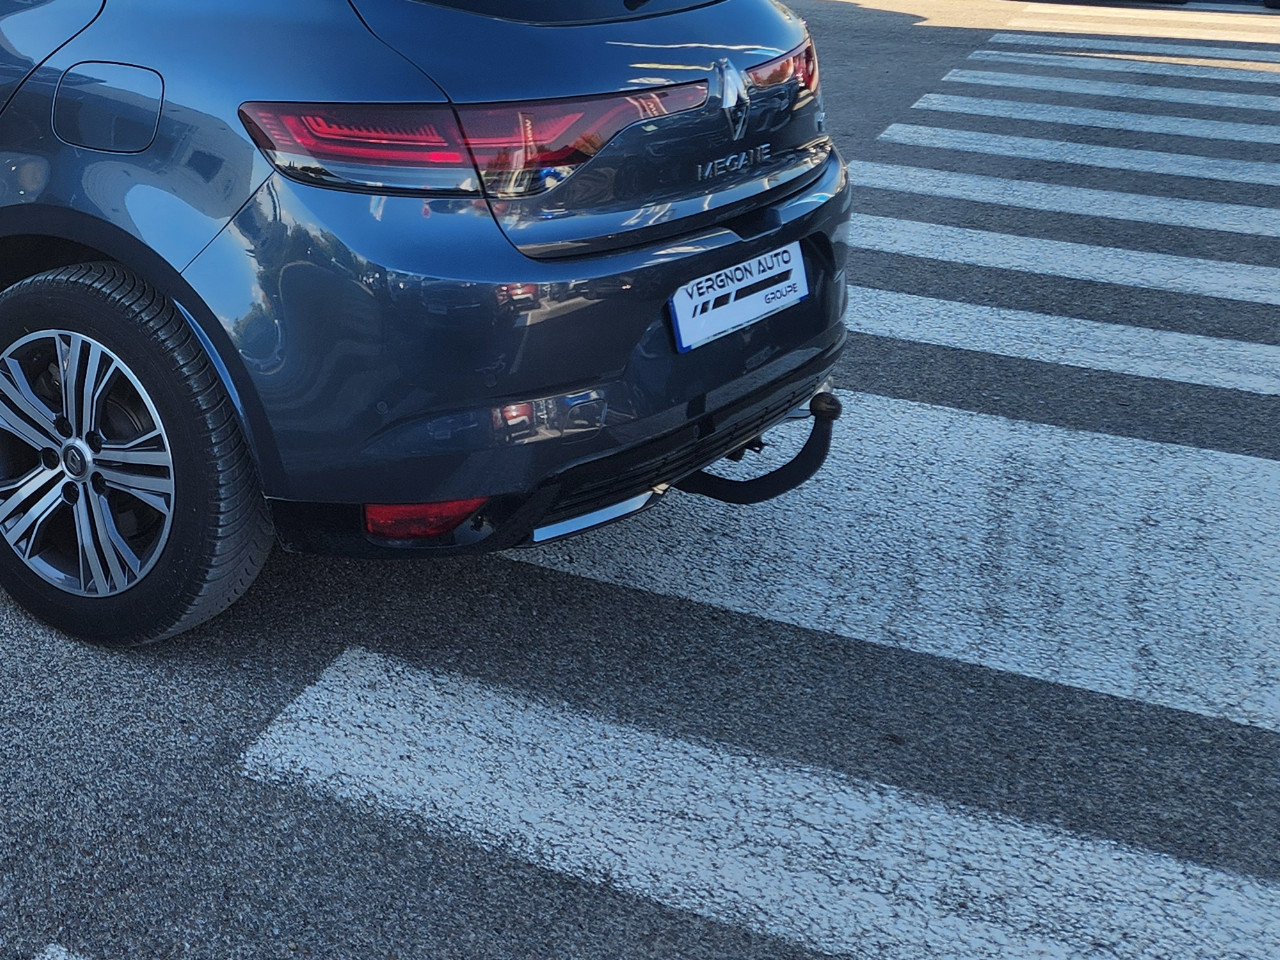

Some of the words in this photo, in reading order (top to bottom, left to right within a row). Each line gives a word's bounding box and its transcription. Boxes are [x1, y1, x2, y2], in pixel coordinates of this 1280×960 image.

[696, 143, 771, 181] MEGANE
[685, 261, 754, 301] VERGNON
[757, 248, 793, 275] AUTO
[763, 282, 798, 305] GROUPE
